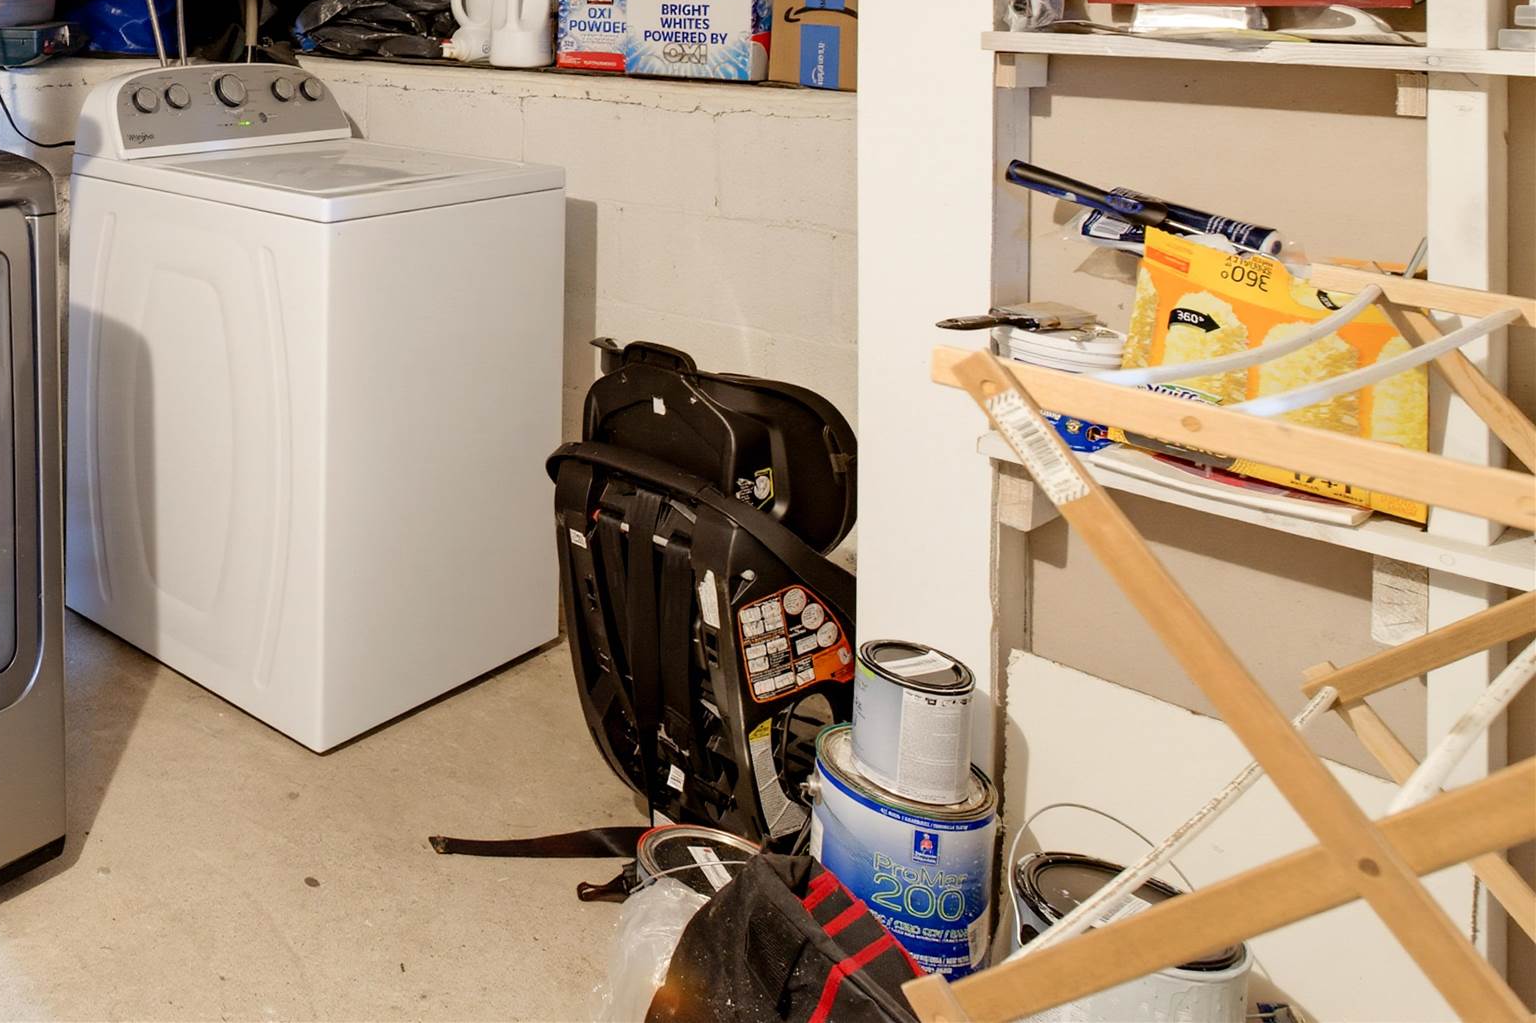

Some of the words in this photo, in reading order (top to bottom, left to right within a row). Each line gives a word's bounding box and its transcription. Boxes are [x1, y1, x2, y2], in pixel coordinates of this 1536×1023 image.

[588, 7, 612, 19] OXI
[661, 3, 710, 17] BRIGHT
[660, 17, 710, 30] WHITES
[644, 30, 707, 44] POWERED
[711, 33, 728, 45] BY
[662, 43, 708, 65] OXI
[873, 851, 968, 889] ProMar
[871, 872, 967, 922] 200
